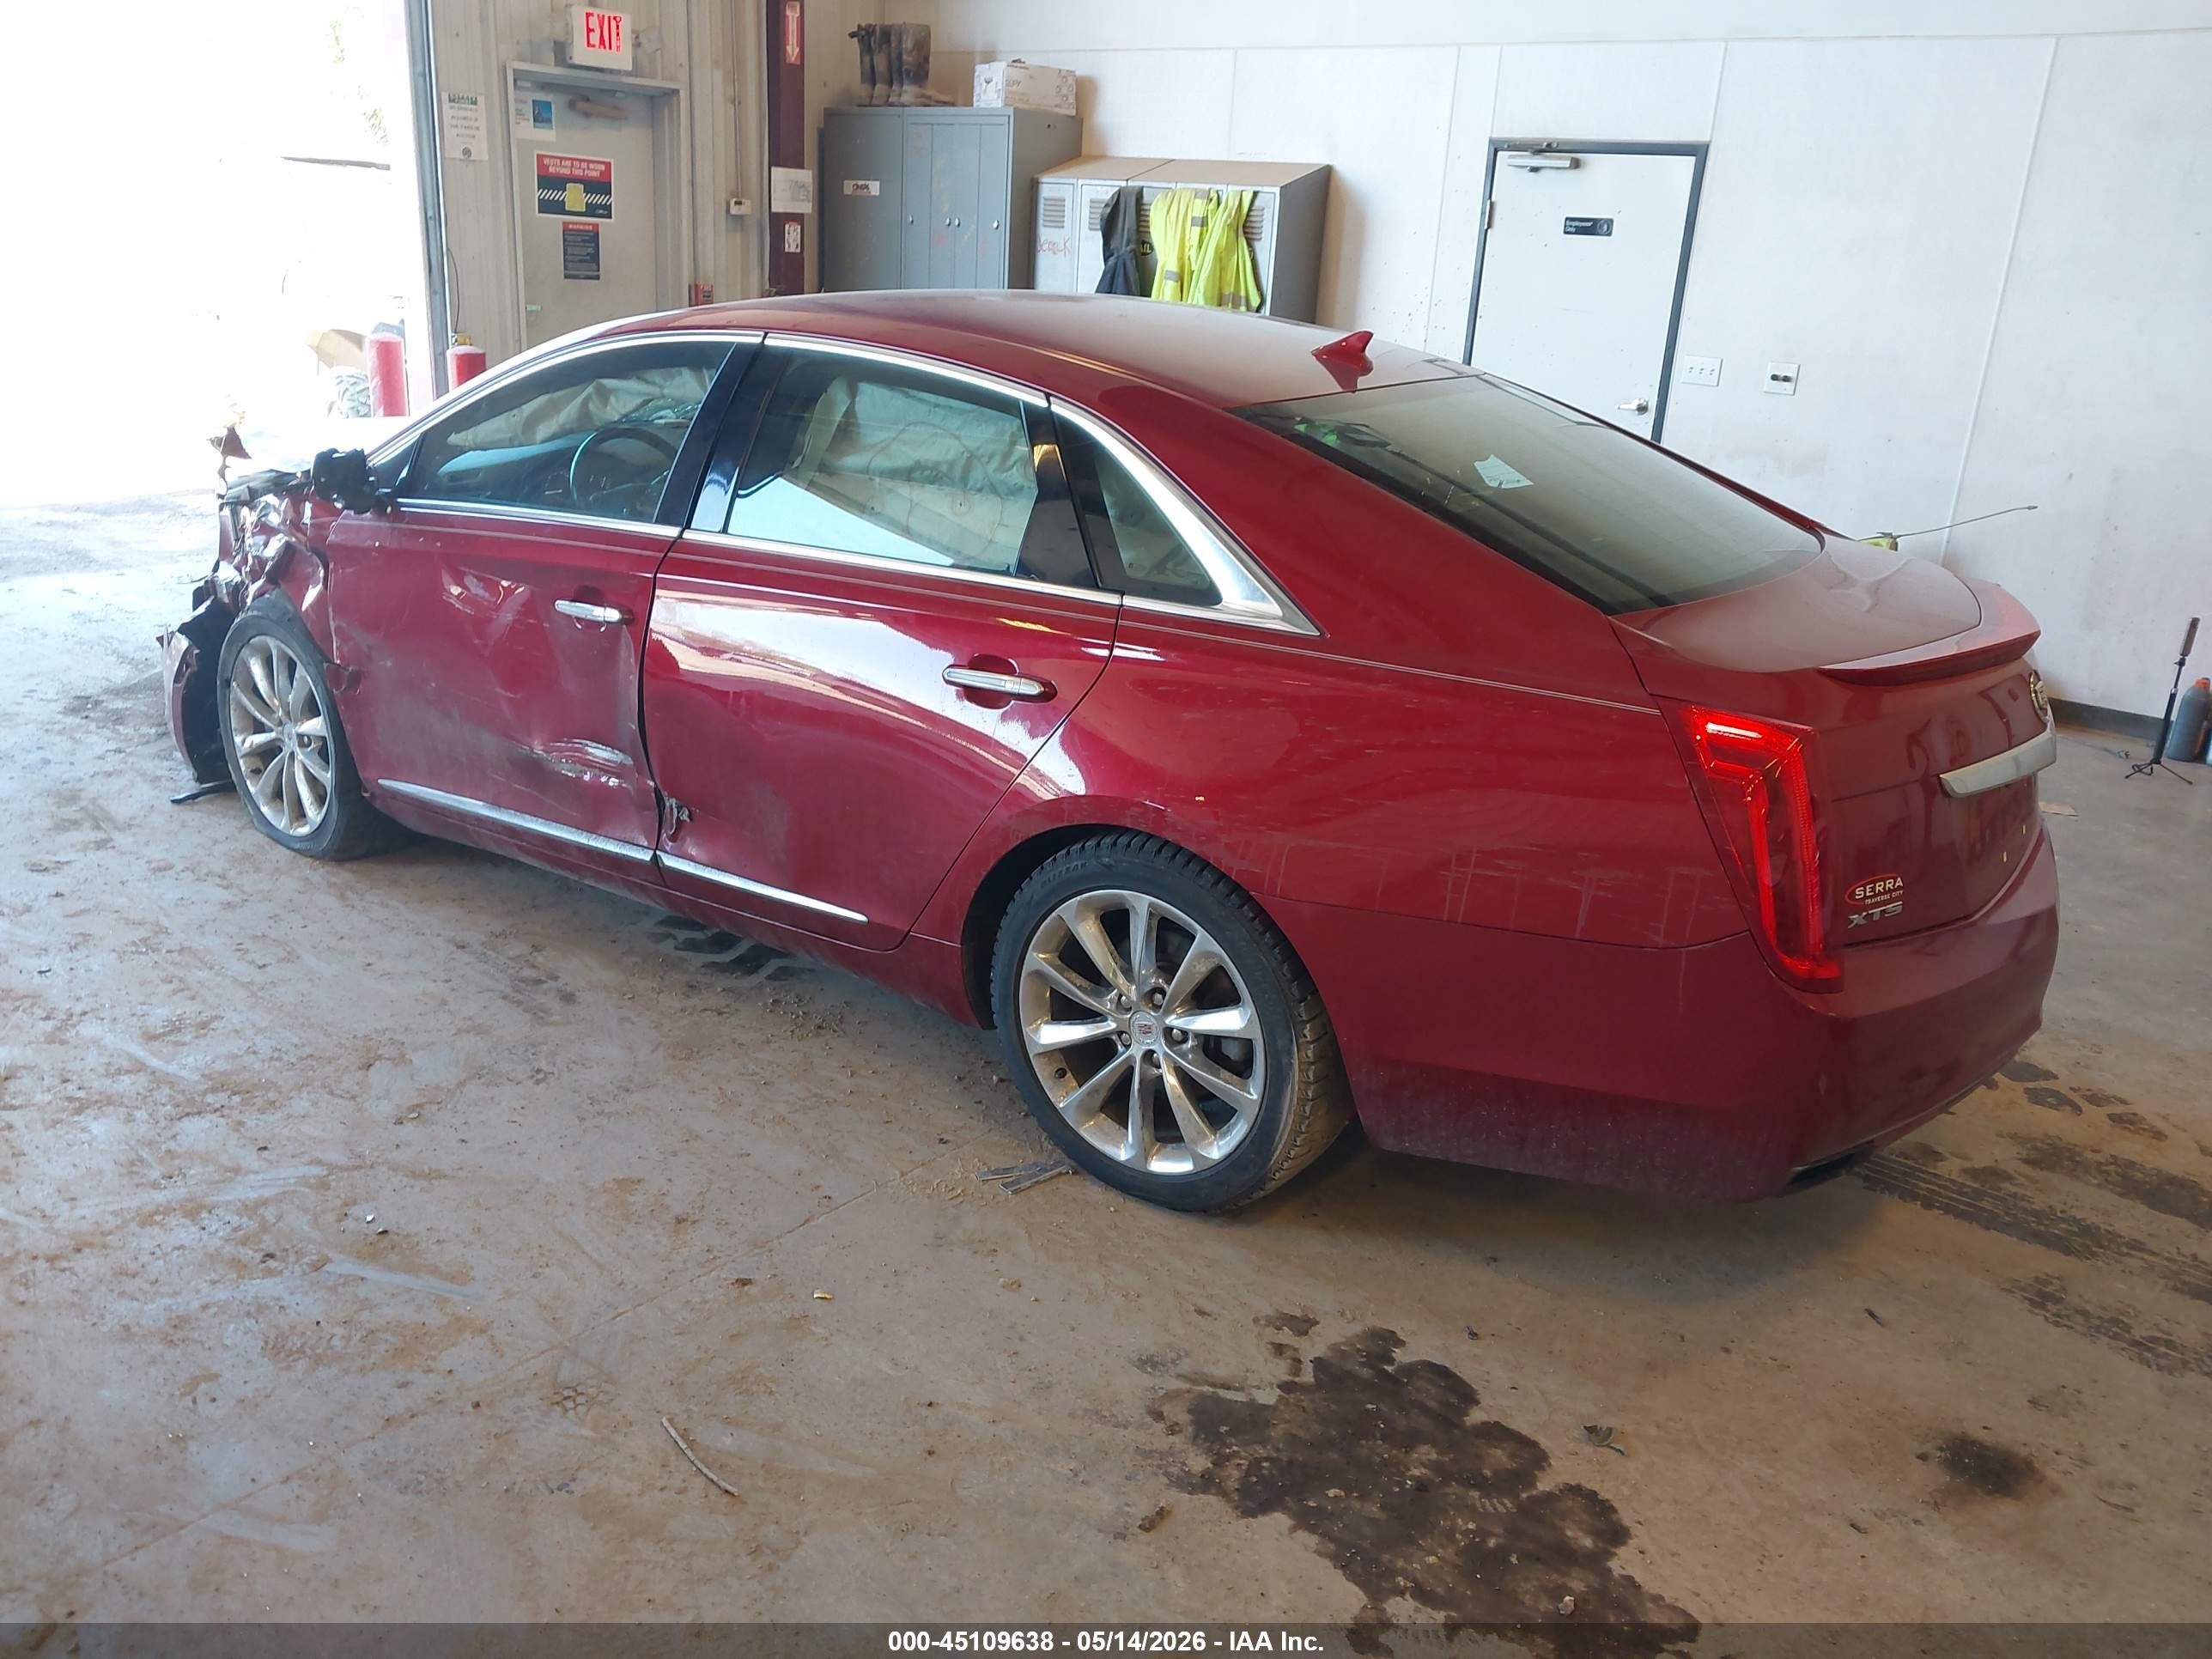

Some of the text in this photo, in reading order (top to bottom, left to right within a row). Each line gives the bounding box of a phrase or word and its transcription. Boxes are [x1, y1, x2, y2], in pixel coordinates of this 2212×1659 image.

[585, 11, 623, 52] EXIT
[543, 157, 561, 166] VESTS
[585, 169, 601, 178] POINT
[1855, 877, 1904, 899] SERRA
[1864, 890, 1904, 905] TRAVERSE CITY
[1848, 901, 1904, 928] XTS
